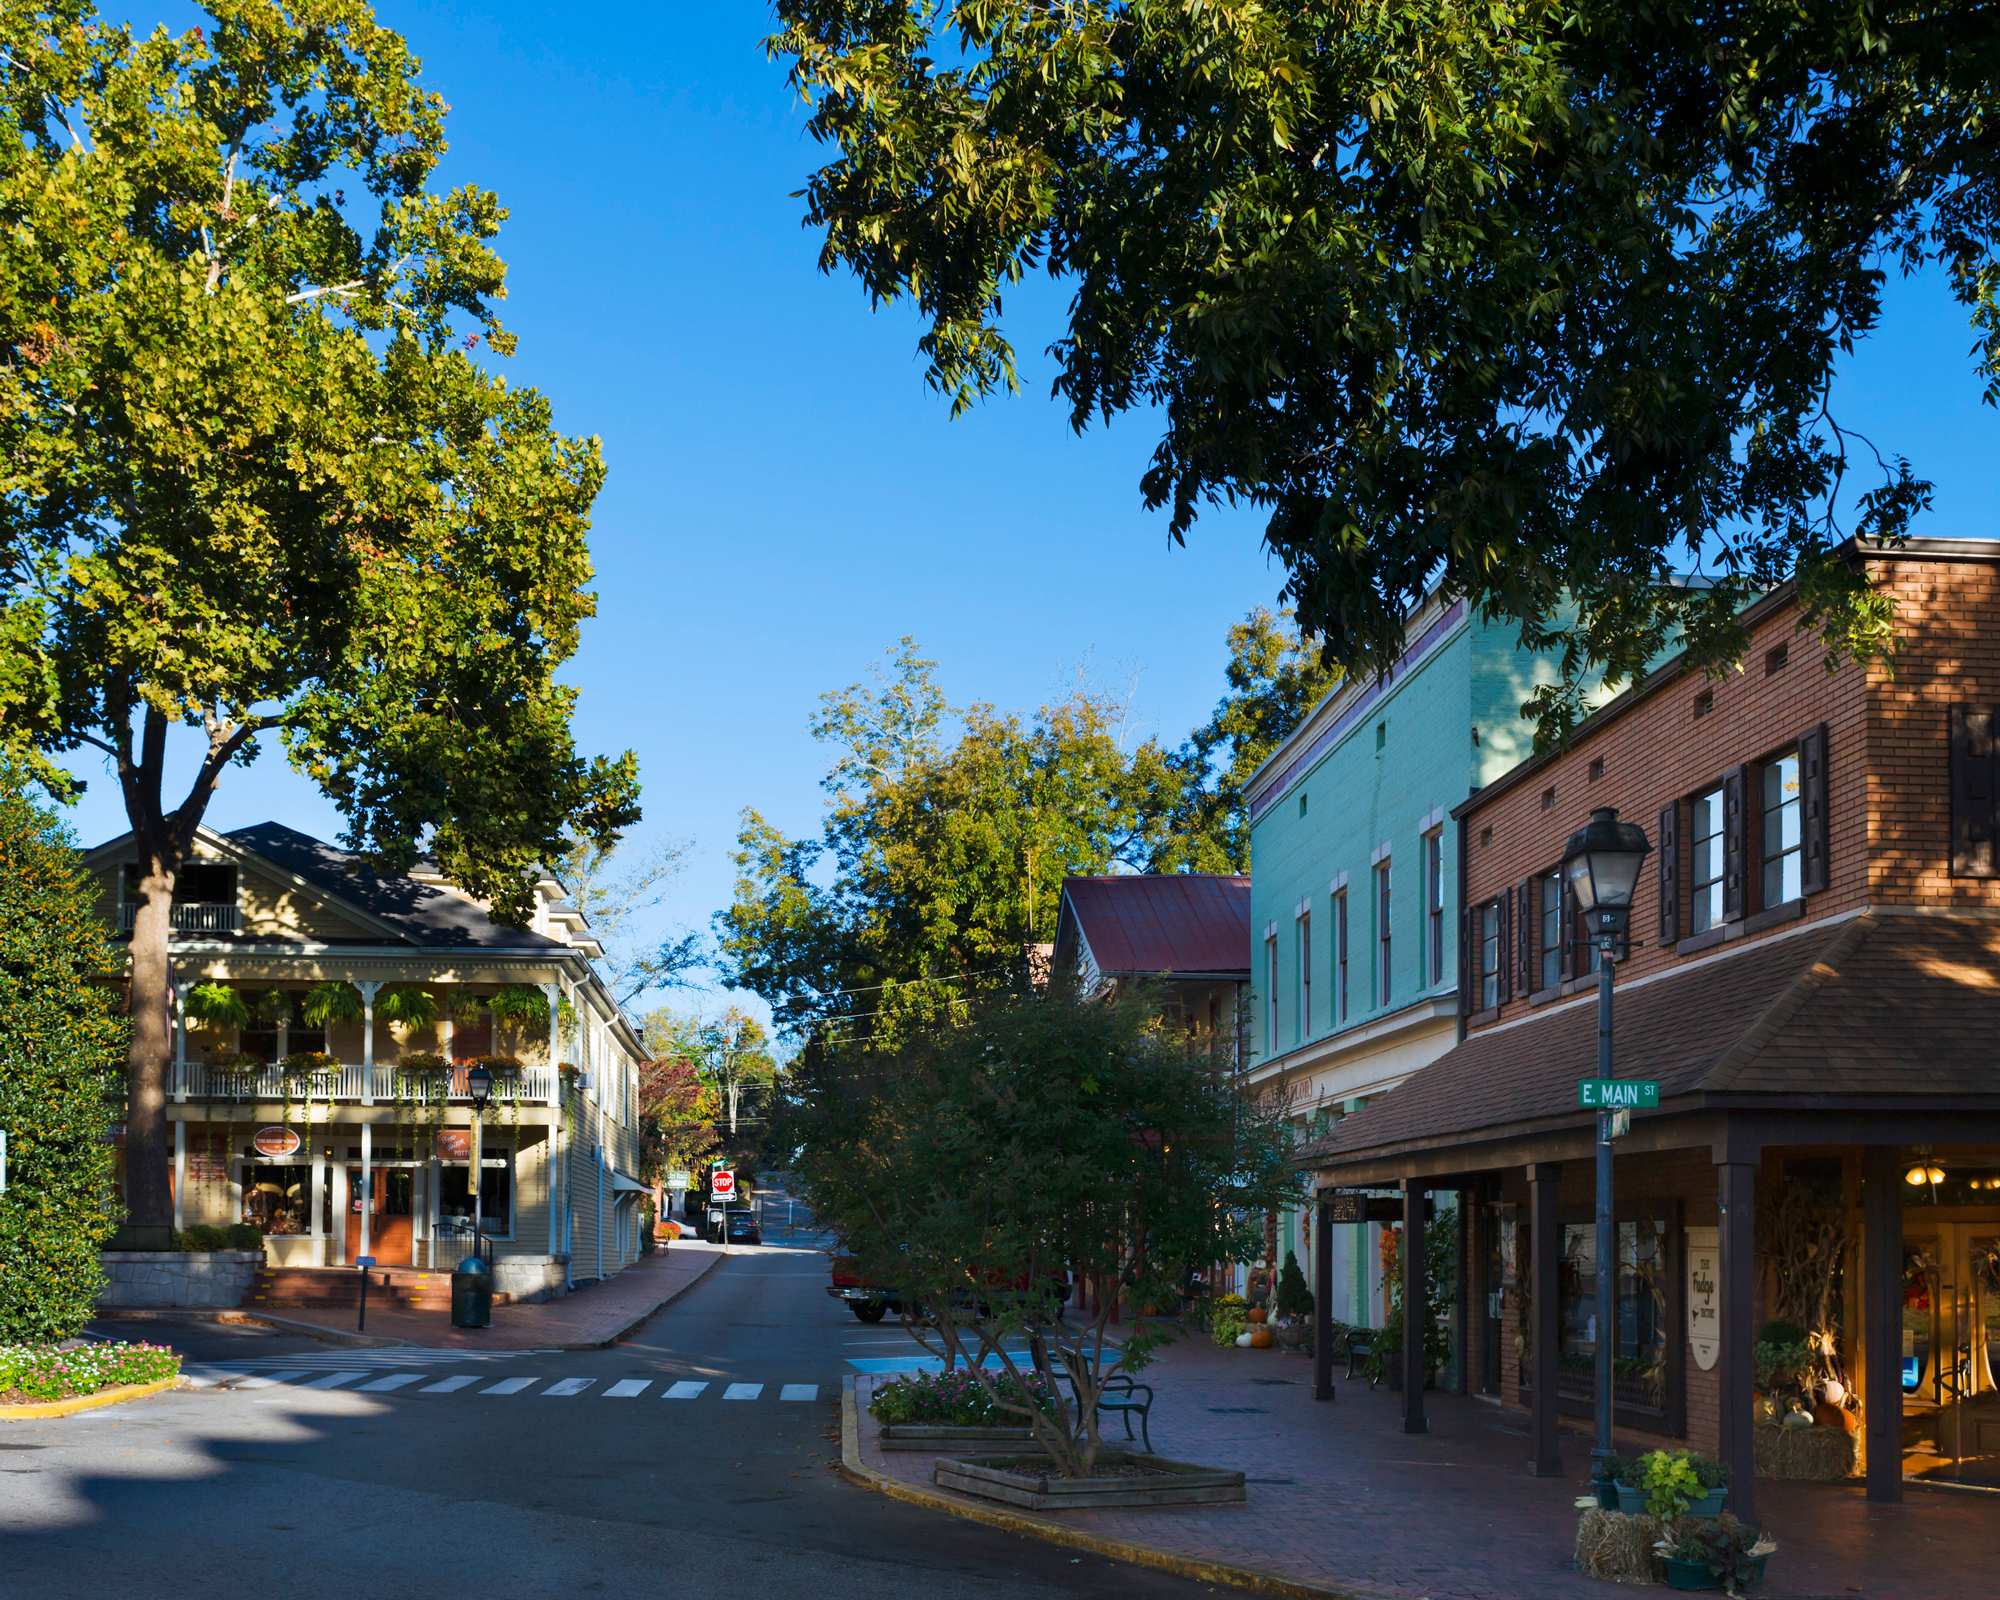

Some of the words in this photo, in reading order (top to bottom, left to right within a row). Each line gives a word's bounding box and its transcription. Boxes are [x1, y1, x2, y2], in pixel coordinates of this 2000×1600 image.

[1583, 1084, 1596, 1104] E.
[1601, 1084, 1638, 1105] MAIN
[1644, 1085, 1655, 1096] ST
[714, 1177, 732, 1187] STOP
[1700, 1258, 1710, 1270] THE
[1692, 1271, 1714, 1306] Fudge
